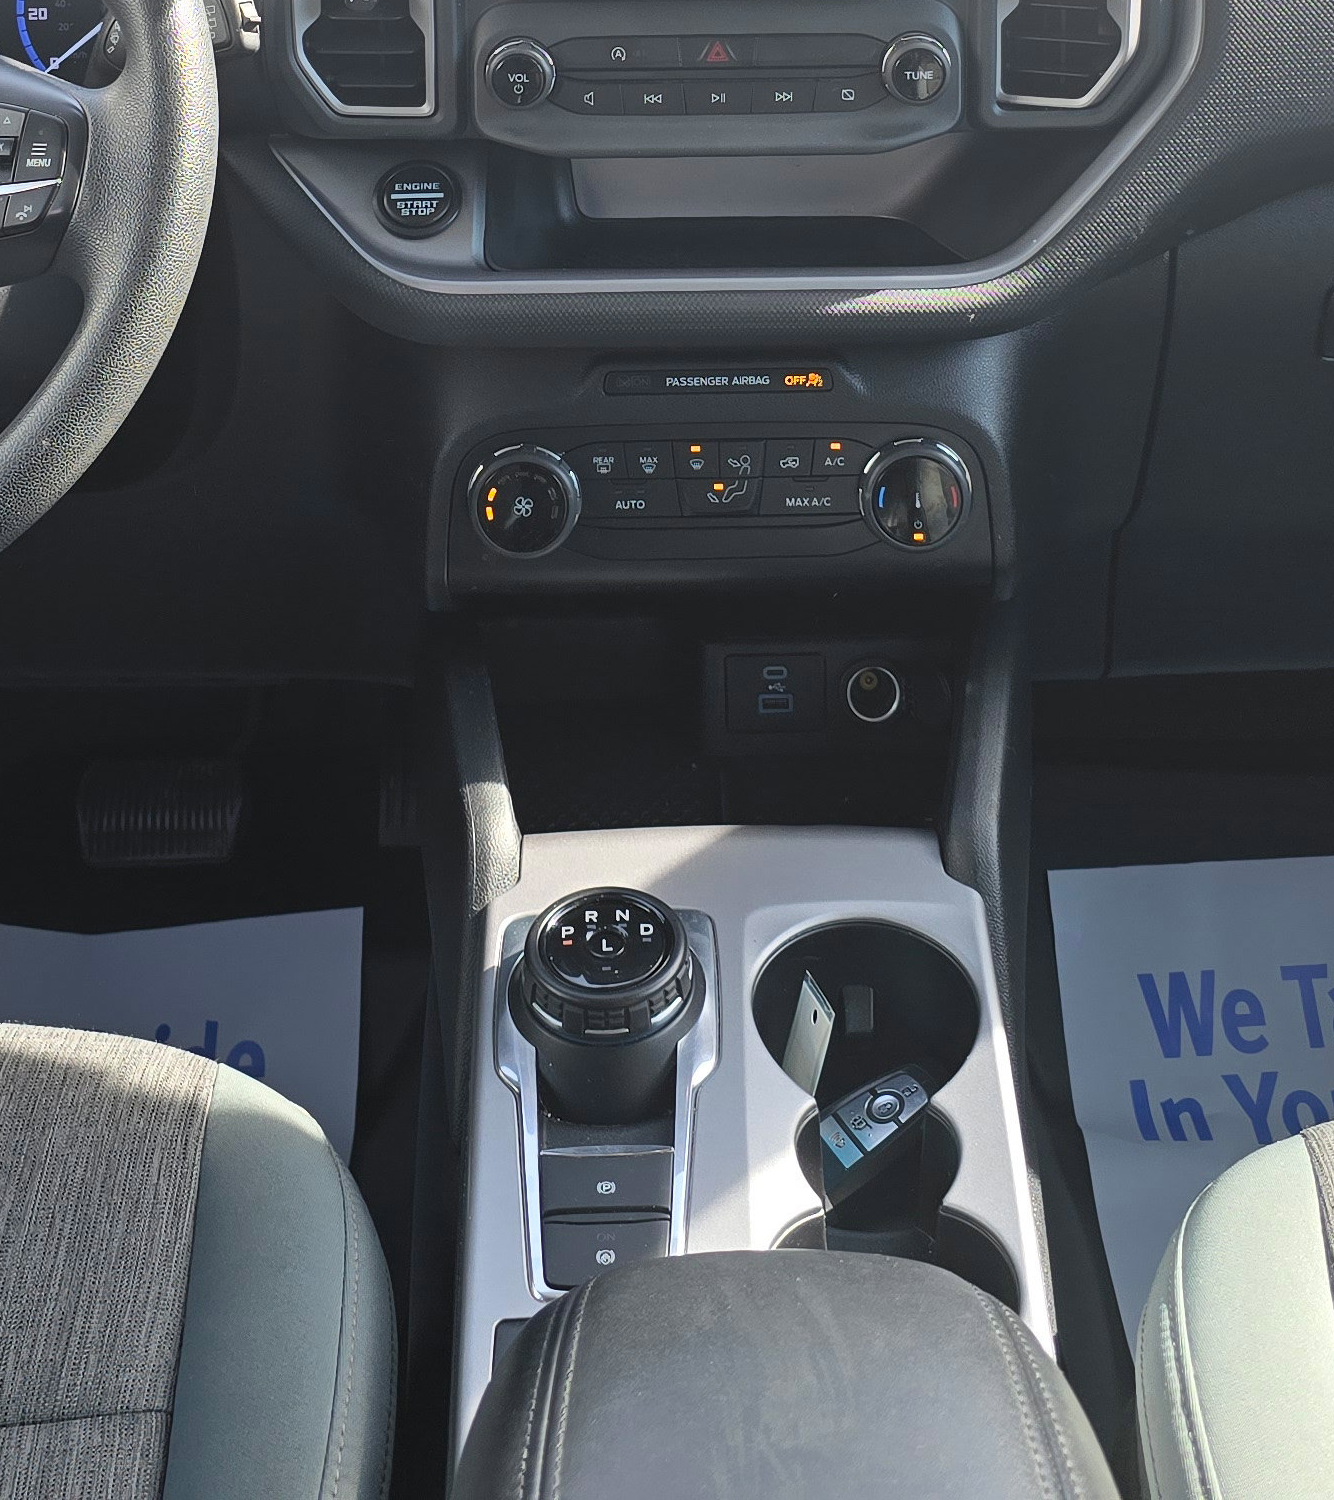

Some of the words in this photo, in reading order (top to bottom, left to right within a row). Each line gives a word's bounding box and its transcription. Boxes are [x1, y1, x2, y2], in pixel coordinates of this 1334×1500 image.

[28, 7, 48, 21] 20
[507, 73, 530, 83] VOL
[903, 70, 934, 81] TUNE
[25, 158, 52, 168] MENU
[394, 182, 440, 191] ENGINE
[396, 200, 439, 209] START
[400, 207, 435, 216] STOP
[666, 376, 729, 387] PASSENGER
[731, 375, 770, 386] AIRBAG
[784, 375, 807, 387] OFF
[592, 456, 615, 466] REAR
[639, 456, 658, 464] MAX
[824, 456, 845, 466] A/C
[615, 500, 646, 510] AUTO
[785, 497, 810, 507] MAX
[811, 496, 831, 507] A/C
[584, 910, 599, 923] R
[615, 908, 630, 922] N
[561, 925, 575, 939] P
[639, 923, 654, 936] D
[601, 938, 614, 952] L
[1136, 968, 1269, 1060] We
[1128, 1077, 1215, 1144] In
